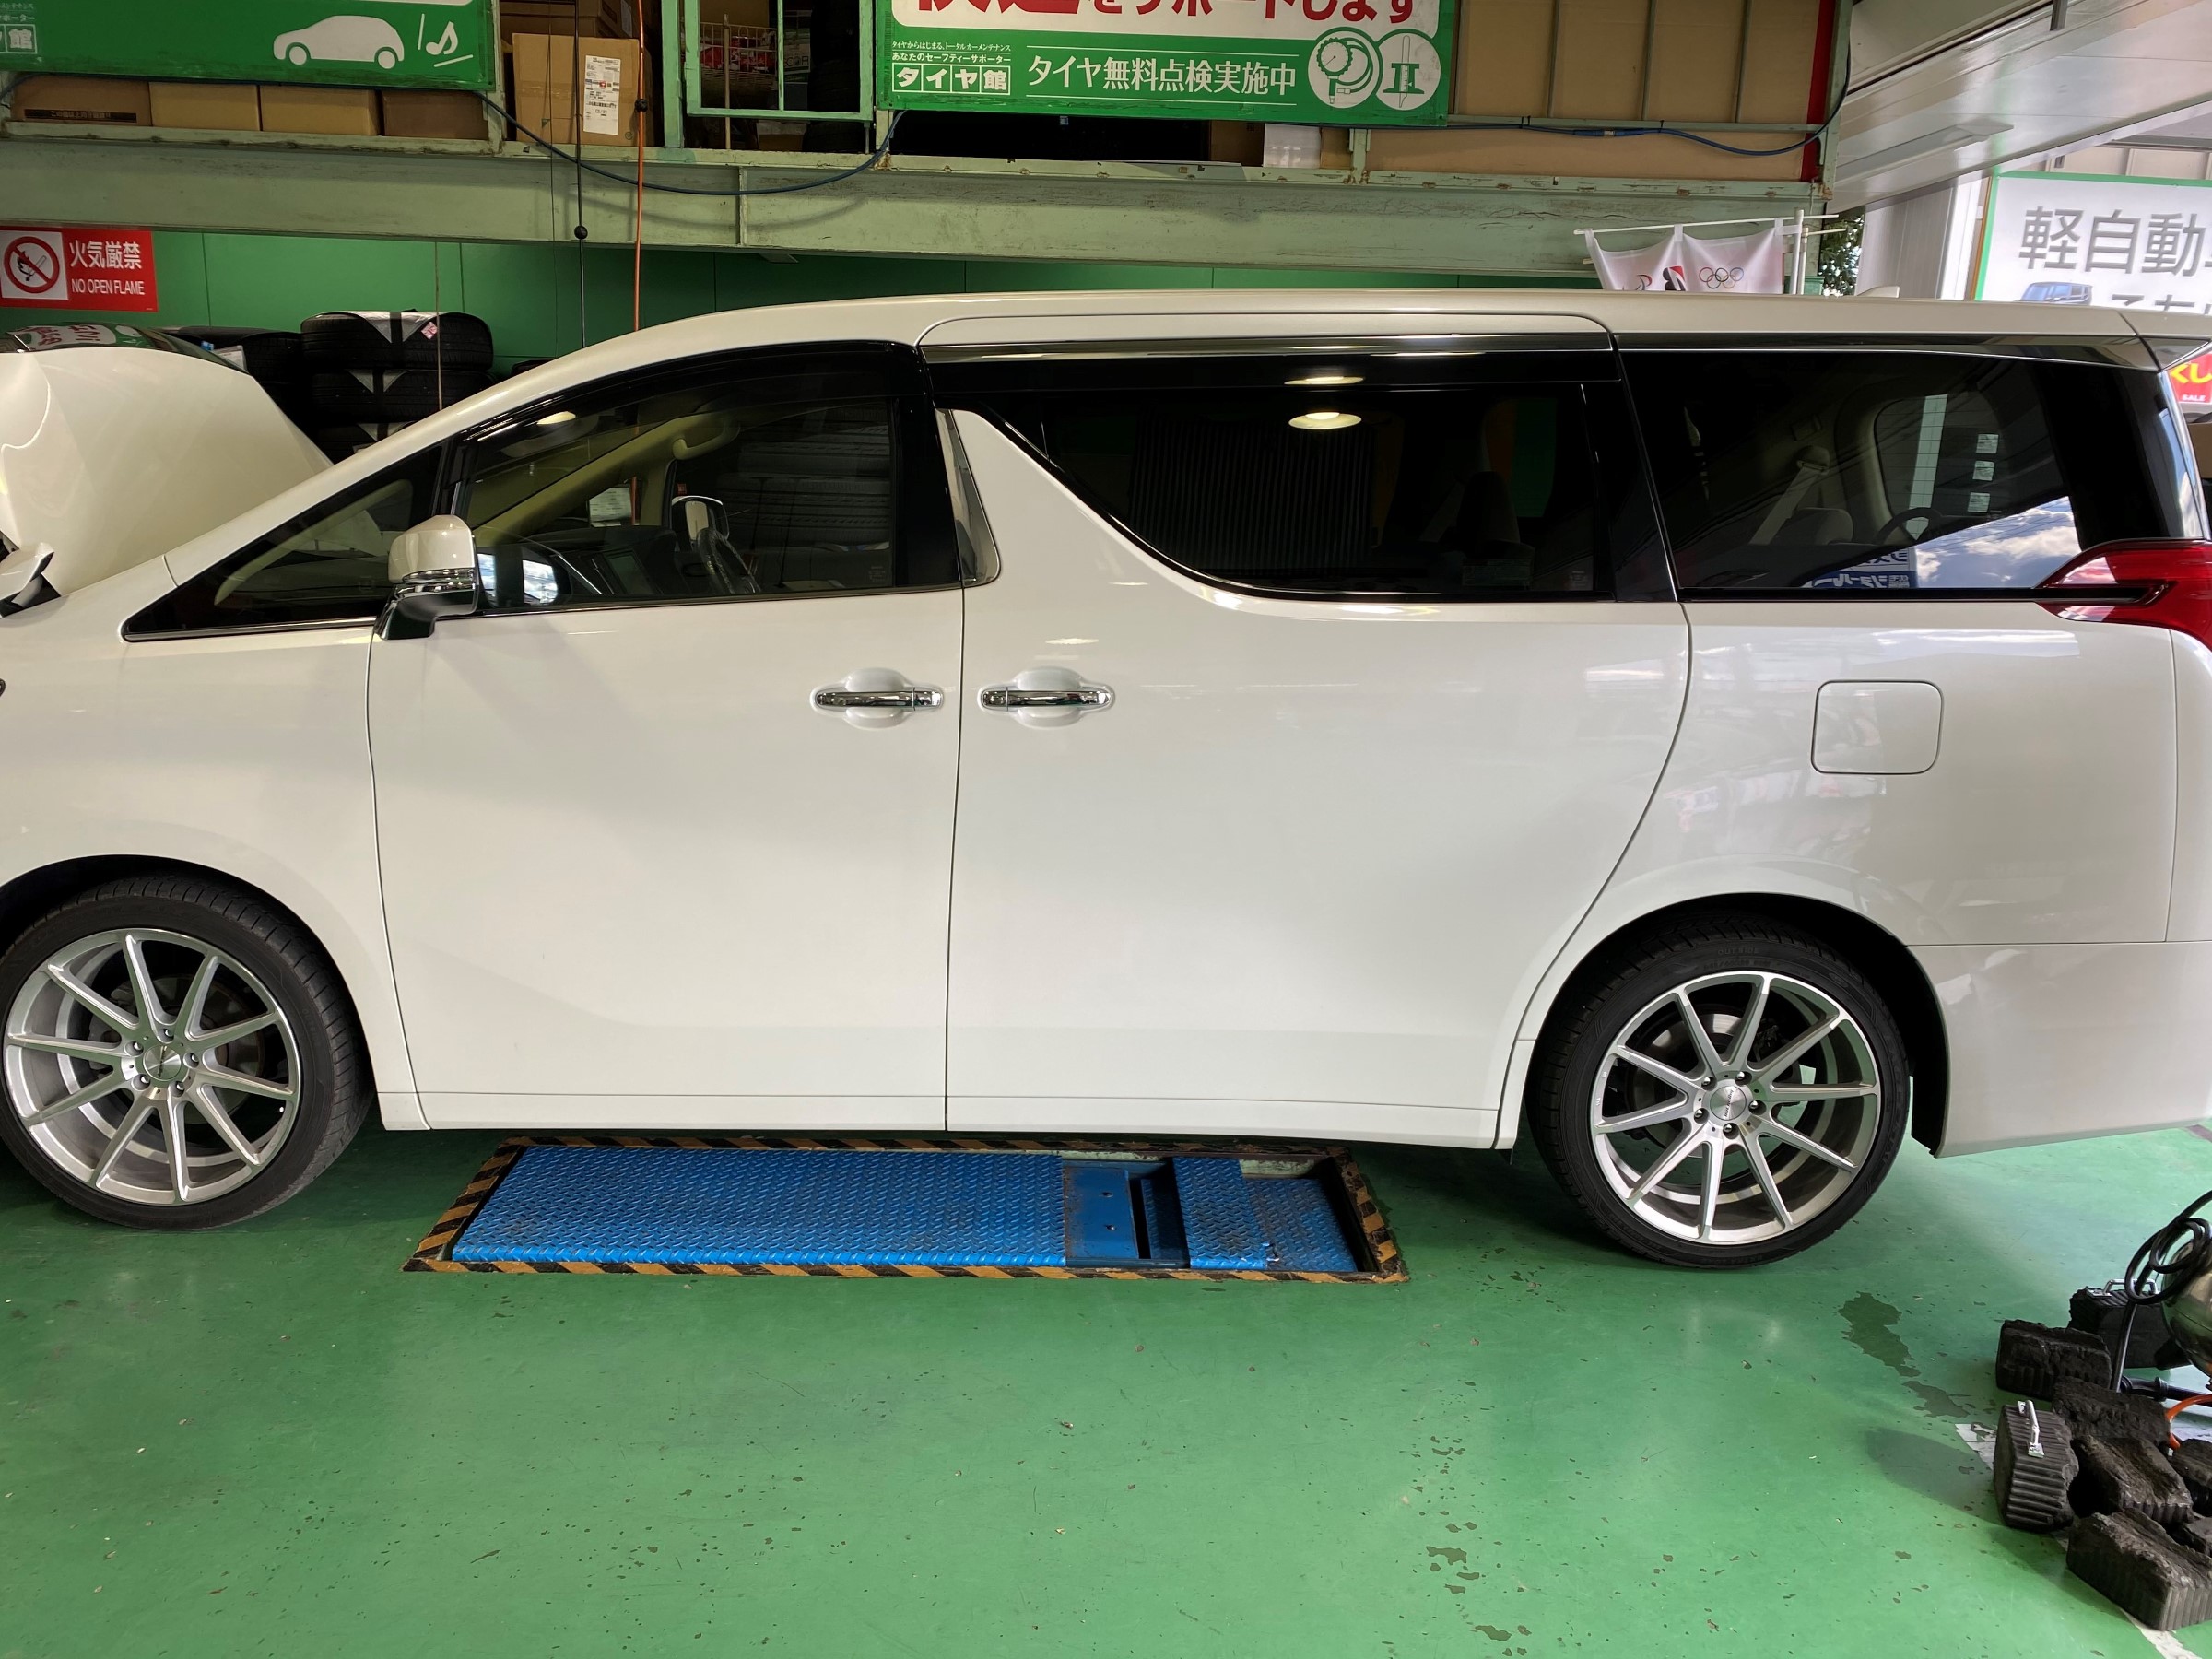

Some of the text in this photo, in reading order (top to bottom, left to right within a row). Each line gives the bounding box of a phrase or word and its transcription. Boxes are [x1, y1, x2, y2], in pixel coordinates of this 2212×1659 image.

[0, 14, 35, 22] ポーター
[892, 52, 1012, 64] あなたのセーフティーサポーター
[896, 66, 1007, 91] タイヤ館
[1028, 55, 1296, 96] タイヤ無料点検実施中
[2018, 206, 2212, 277] 軽自動
[69, 239, 143, 270] 火気厳禁
[71, 278, 146, 295] NO OPEN FLAME
[2182, 394, 2207, 402] SALE
